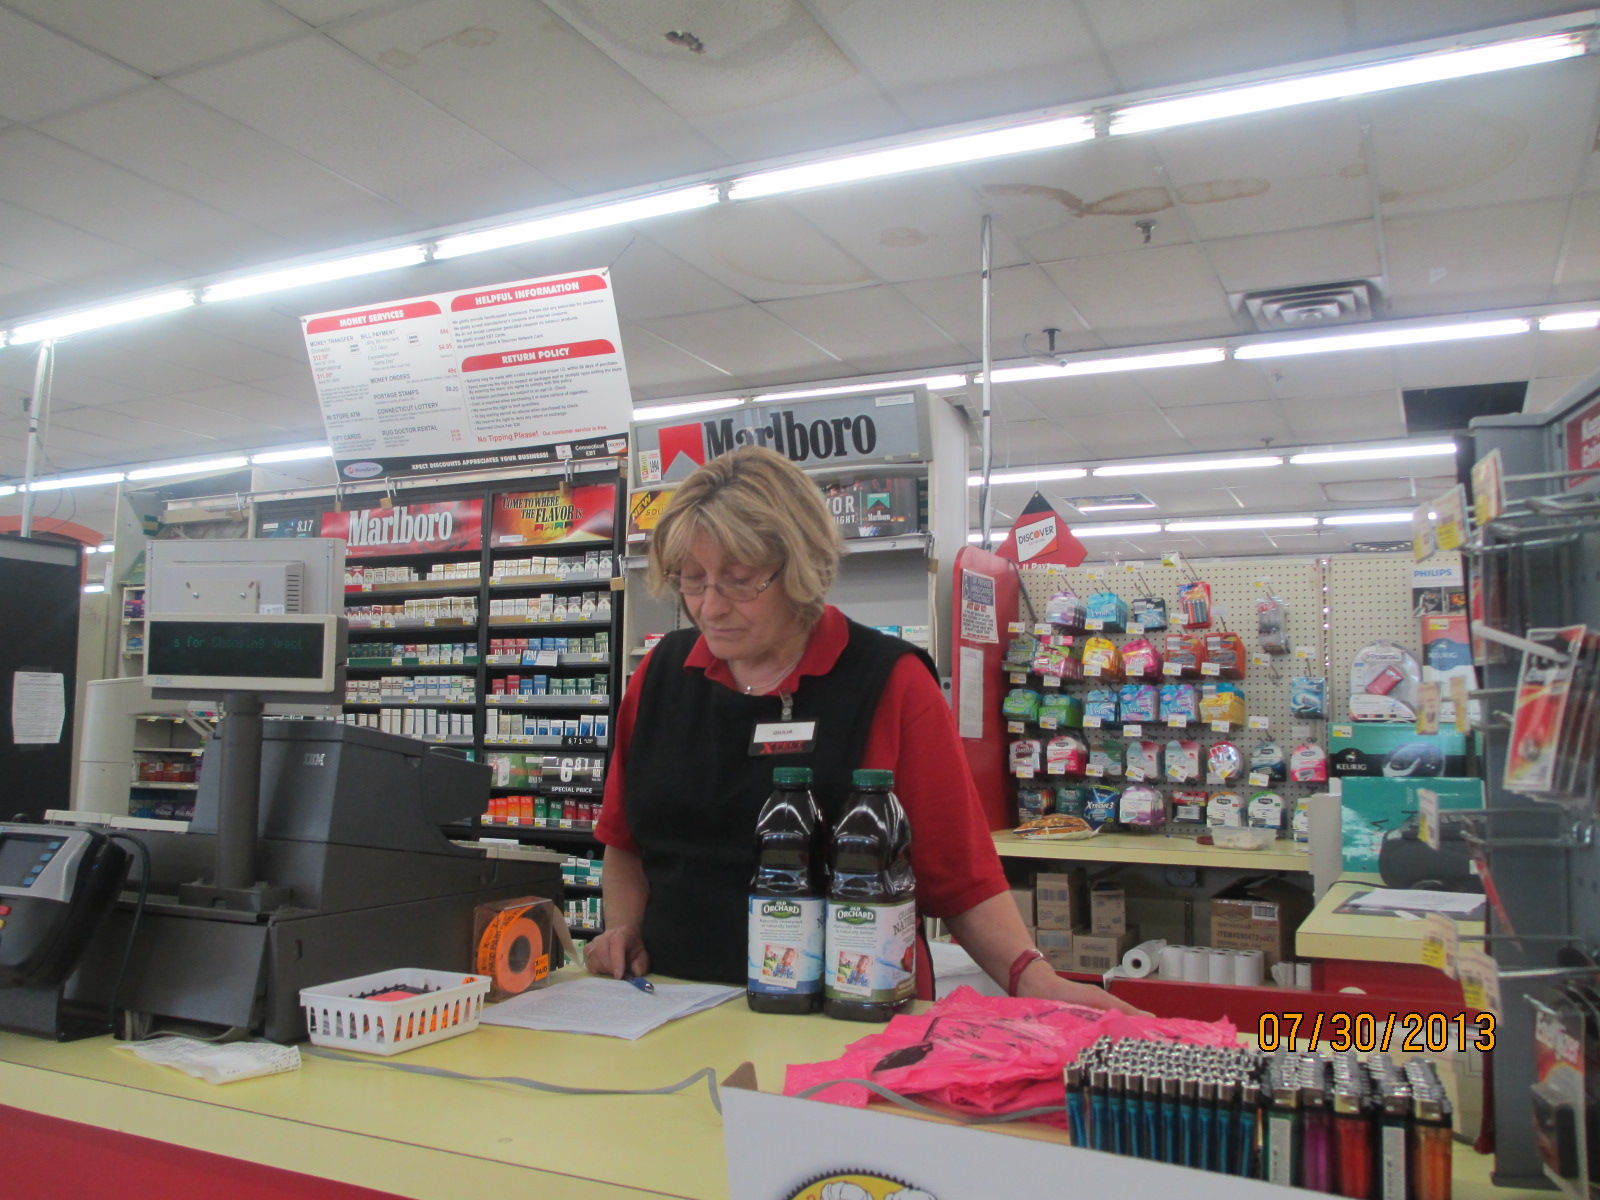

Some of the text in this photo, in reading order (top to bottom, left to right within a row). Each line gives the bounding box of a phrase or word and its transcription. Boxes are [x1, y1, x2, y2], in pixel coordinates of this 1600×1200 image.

[474, 281, 579, 305] HELPFUL INFORMATION
[338, 309, 404, 327] MONEY SERVICES
[328, 335, 353, 343] TRANSFER
[501, 347, 570, 363] RETURN POLICY
[376, 405, 413, 414] CONNECTICUT
[488, 433, 512, 442] Tipping
[513, 430, 538, 438] Please!
[704, 411, 876, 462] Marlboro
[429, 460, 462, 470] DISCOUNTS
[462, 457, 499, 467] APPRECIATES
[500, 455, 517, 463] YOUR
[518, 452, 549, 462] BUSINESS!
[503, 496, 559, 509] COME TO WHERE
[631, 494, 652, 520] NEW
[521, 509, 535, 519] THE
[535, 506, 574, 522] FLAVOR
[297, 520, 314, 532] 8.17
[347, 506, 453, 547] Marlboro
[1018, 526, 1054, 544] DISCOVER
[1414, 568, 1452, 578] PHILIPS
[187, 636, 205, 648] for
[212, 637, 265, 649] Choosing
[272, 637, 304, 649] Xpect
[1089, 707, 1110, 715] Venus
[303, 753, 326, 767] IBM
[1336, 763, 1367, 771] KEURIG
[1086, 801, 1114, 810] XTREME3
[764, 904, 800, 914] ORCHARD
[837, 910, 874, 920] ORCHARD
[536, 966, 548, 975] PAID
